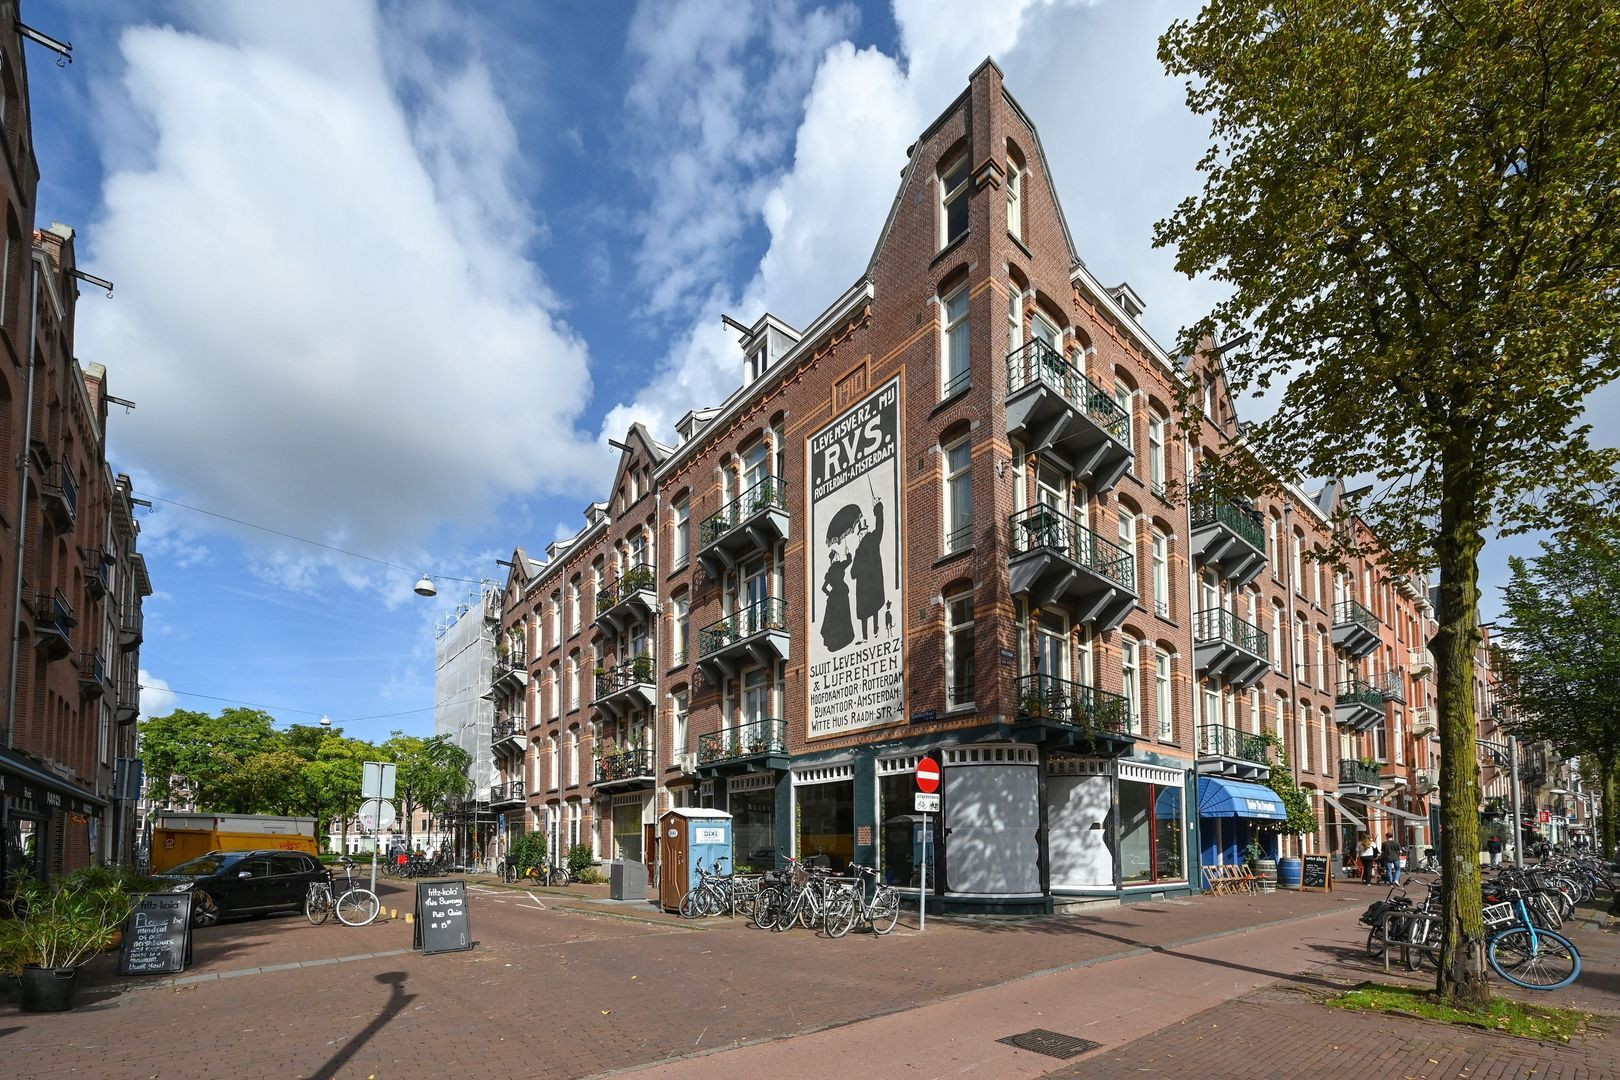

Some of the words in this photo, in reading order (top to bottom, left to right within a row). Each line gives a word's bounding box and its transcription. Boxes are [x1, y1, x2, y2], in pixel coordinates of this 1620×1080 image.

[837, 370, 863, 406] 1910
[810, 660, 832, 678] SLUIT
[813, 681, 821, 692] &
[811, 719, 831, 732] WITTE
[832, 714, 849, 728] HUIS
[428, 887, 458, 896] fritz-kola
[141, 900, 179, 910] fritz-kola
[172, 916, 184, 924] be
